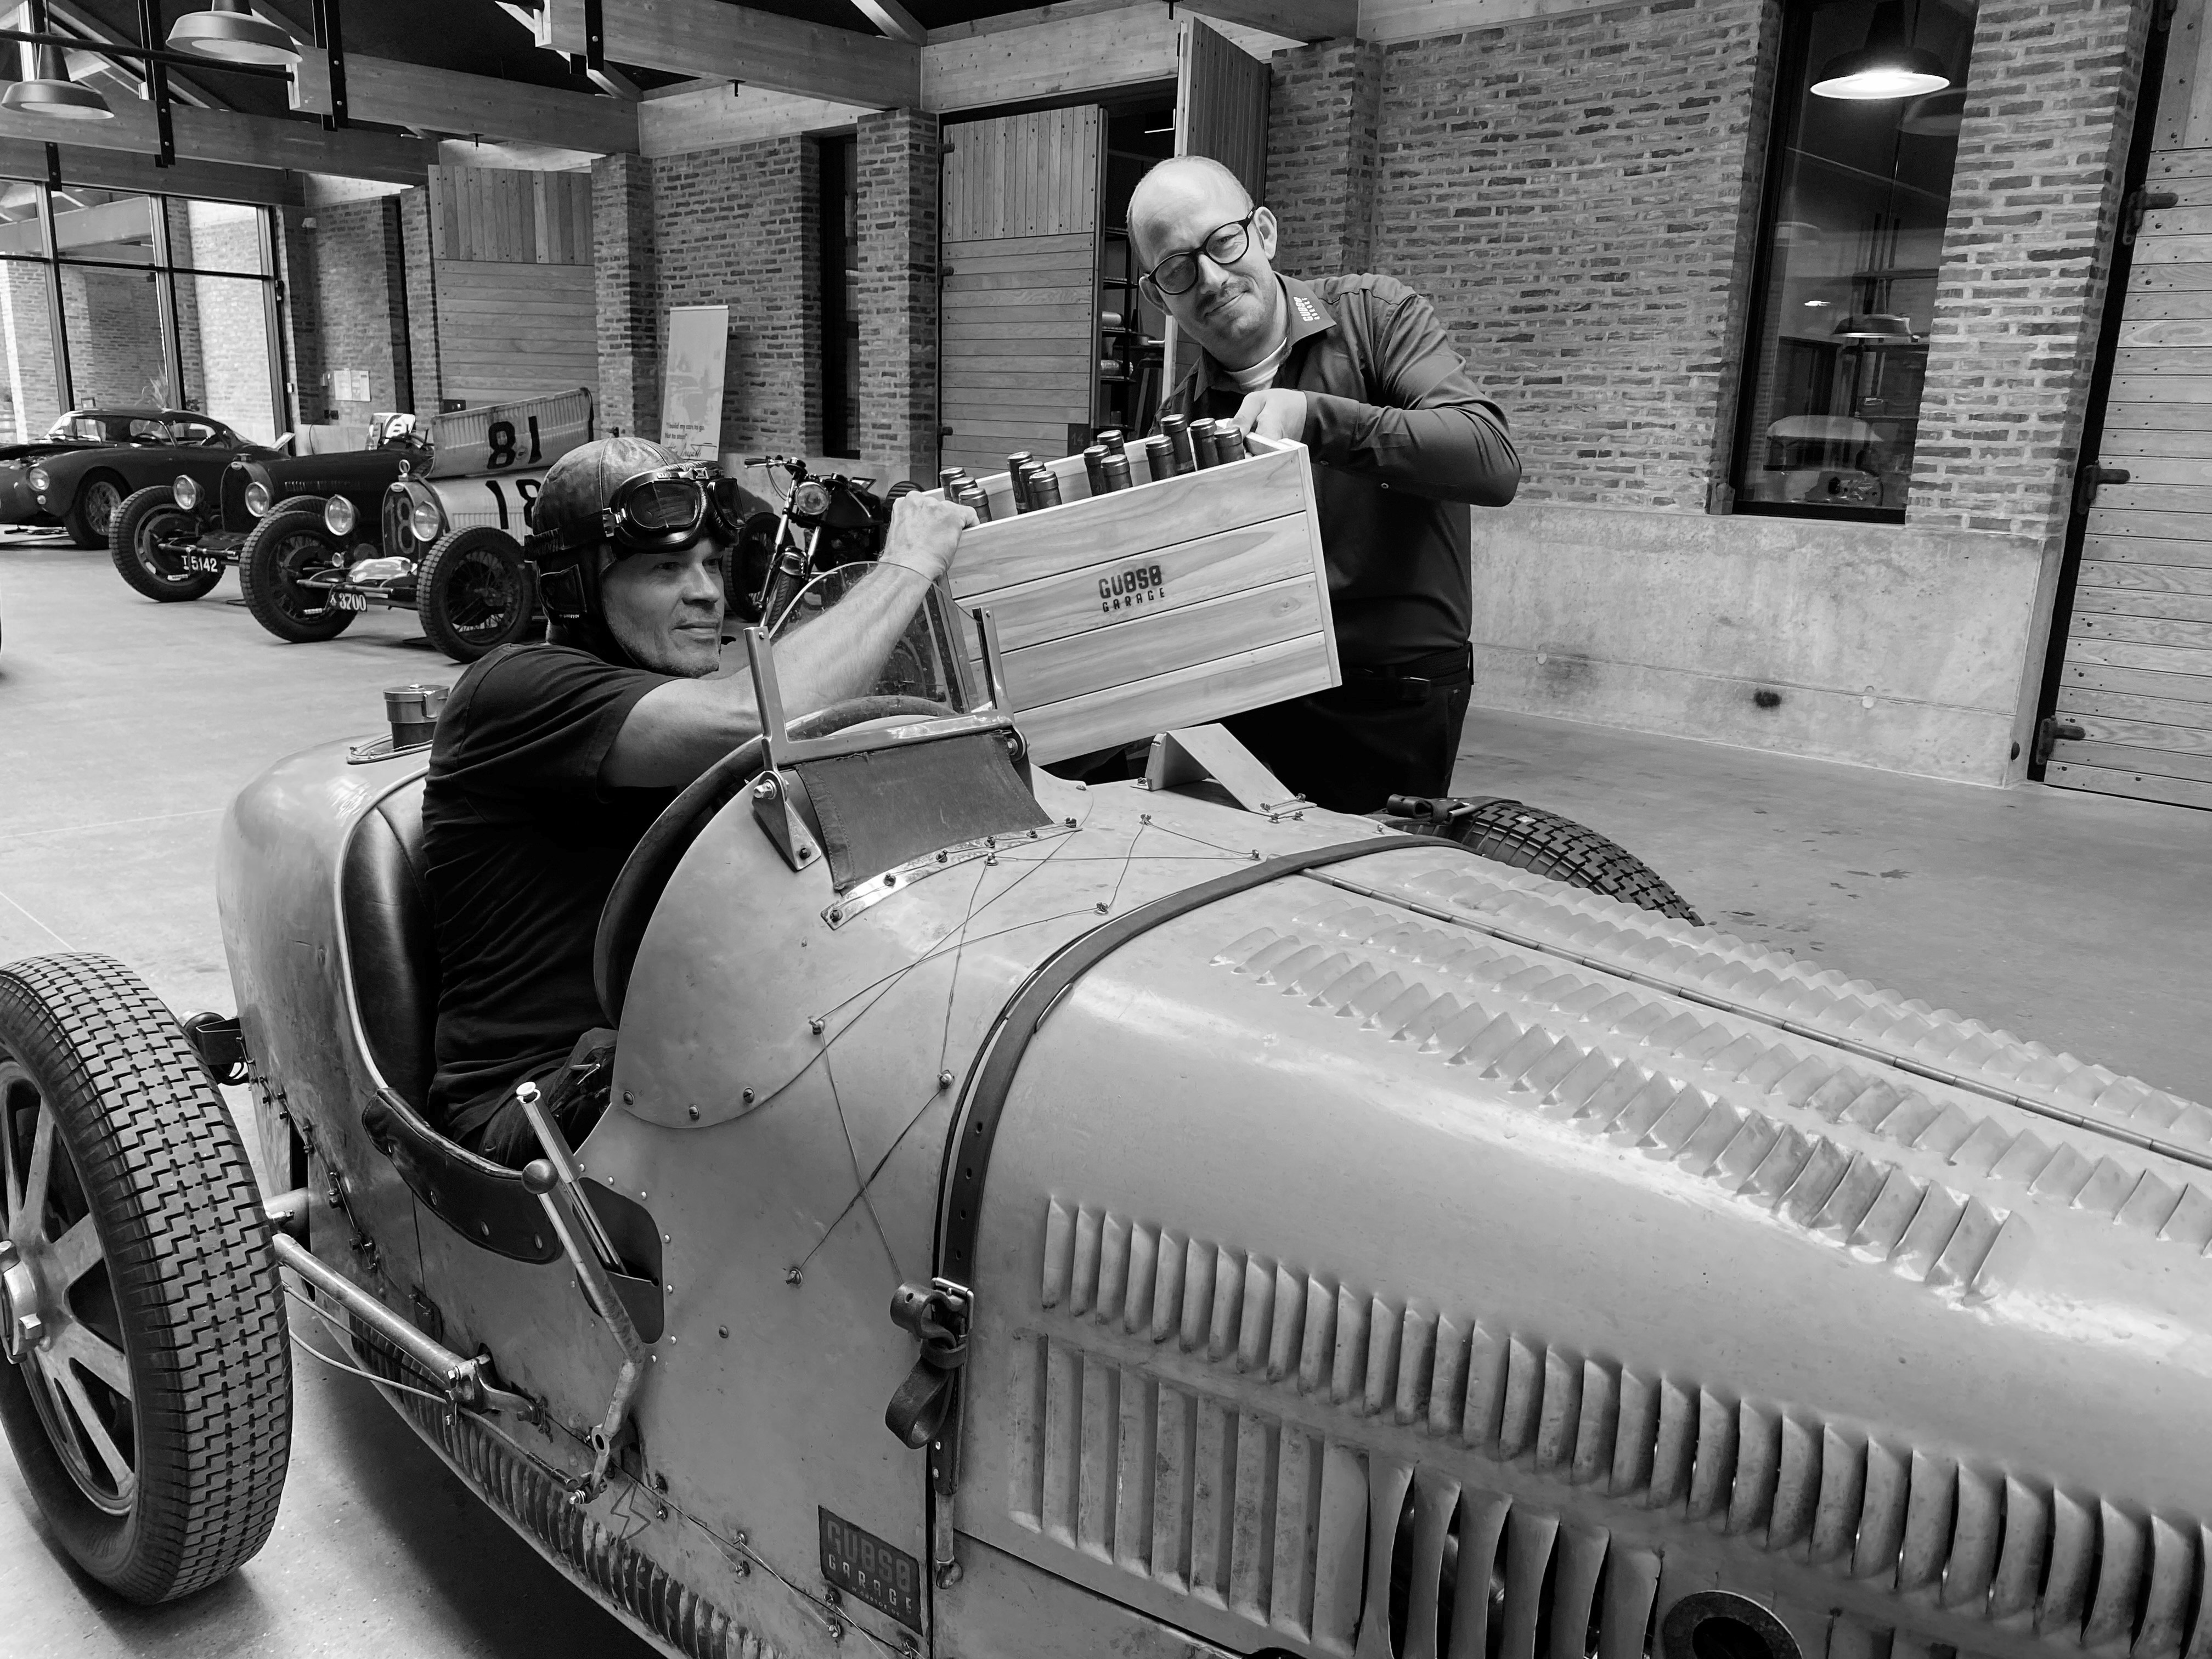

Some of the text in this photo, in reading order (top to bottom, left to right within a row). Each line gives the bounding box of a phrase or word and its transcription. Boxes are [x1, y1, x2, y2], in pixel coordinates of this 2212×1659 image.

[1071, 432, 1084, 445] 14
[385, 496, 416, 554] 18
[191, 556, 218, 572] 5142
[339, 593, 366, 611] 3700
[1102, 588, 1165, 613] GARAGE
[828, 1554, 912, 1614] GARAGE
